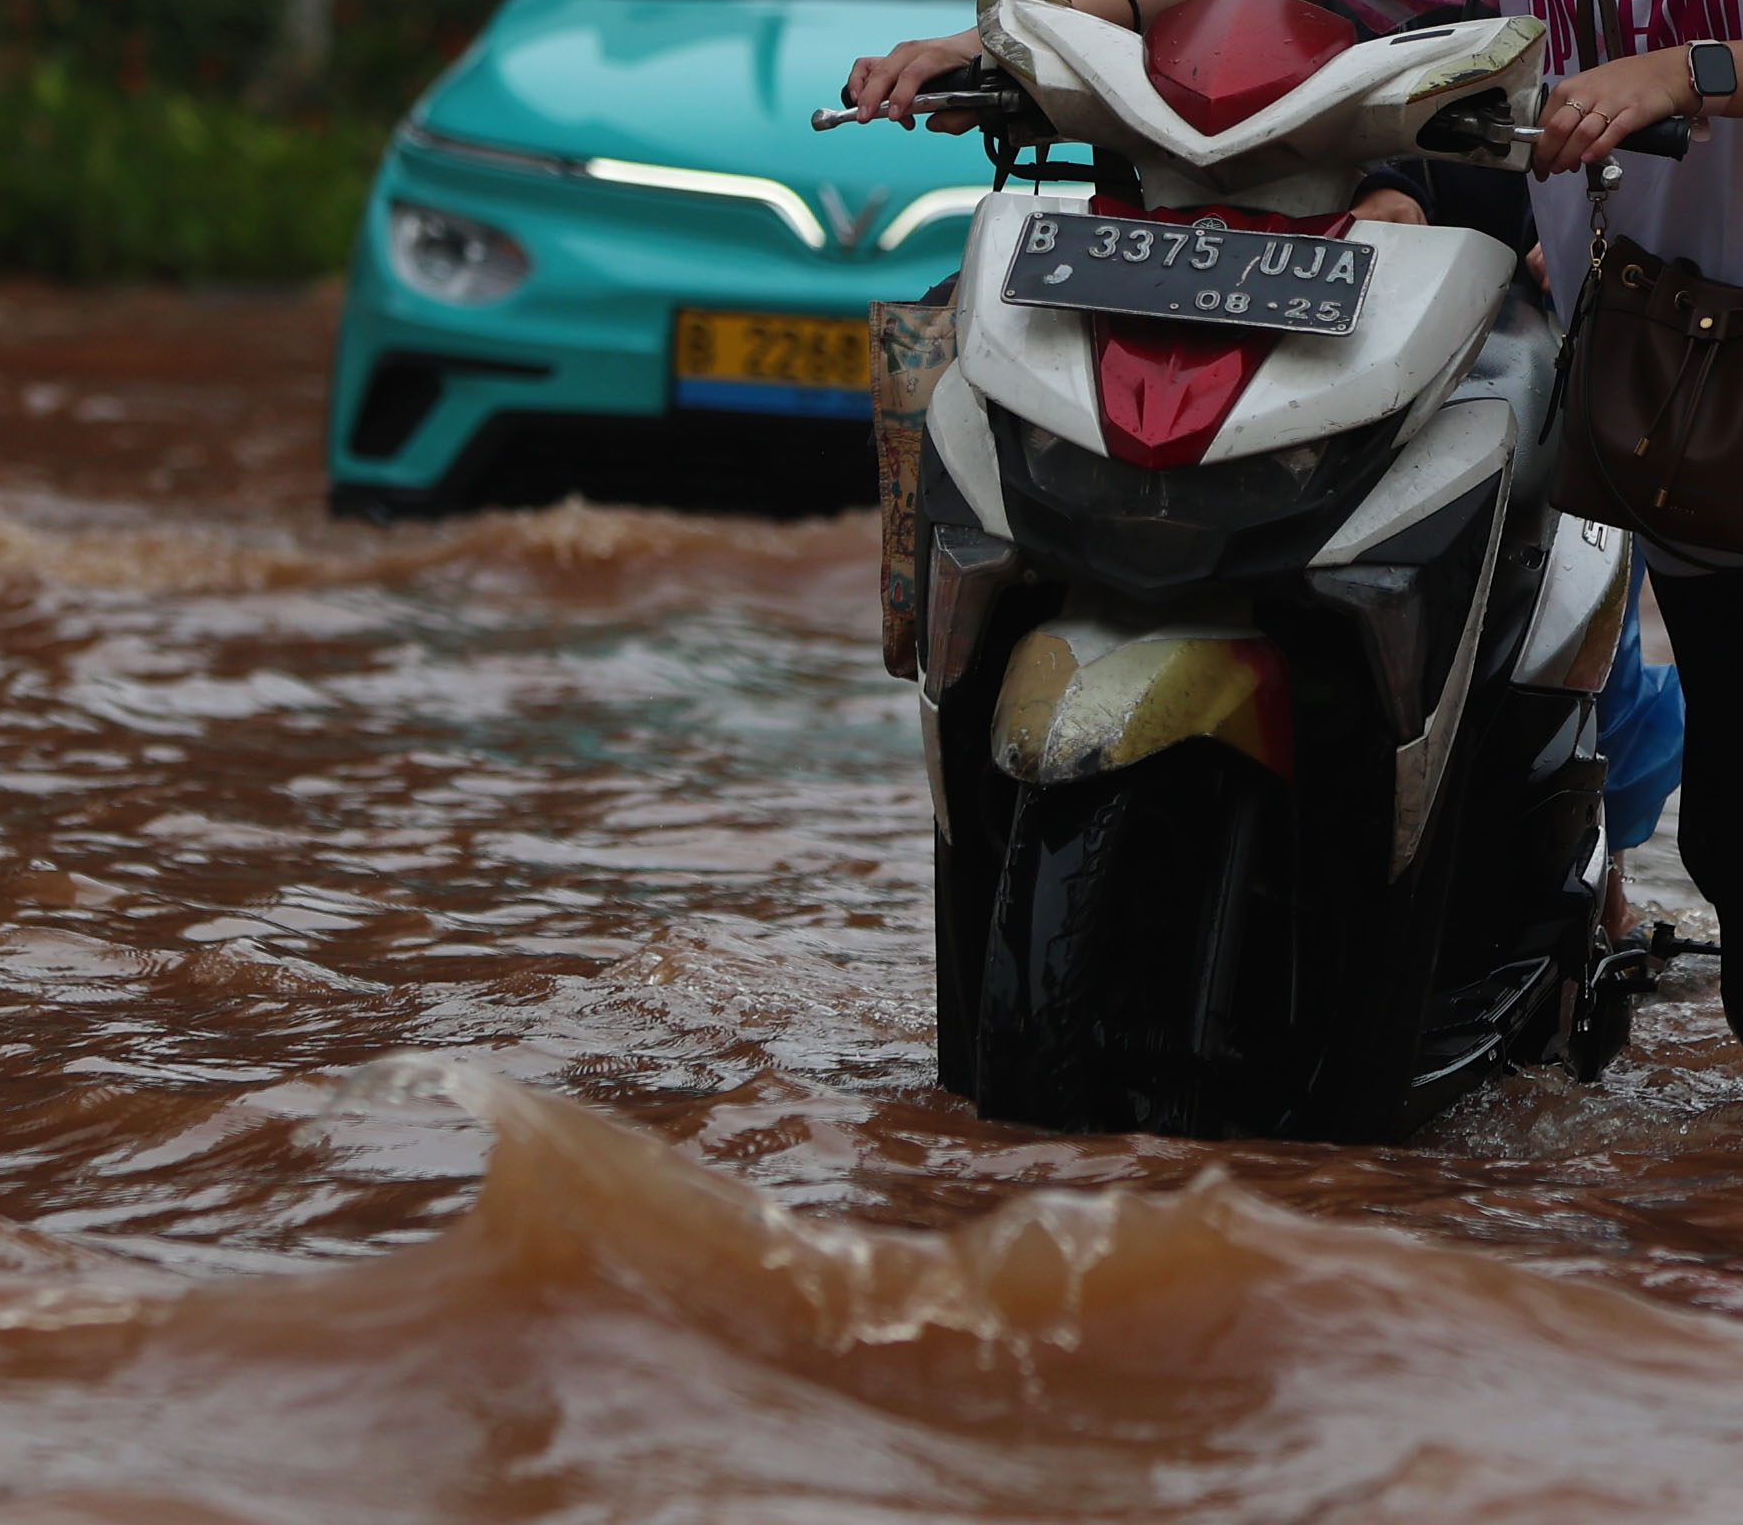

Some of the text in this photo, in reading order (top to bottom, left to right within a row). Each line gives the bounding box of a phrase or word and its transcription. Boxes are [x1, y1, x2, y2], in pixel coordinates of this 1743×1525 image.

[1025, 219, 1356, 286] B 3375 UJA
